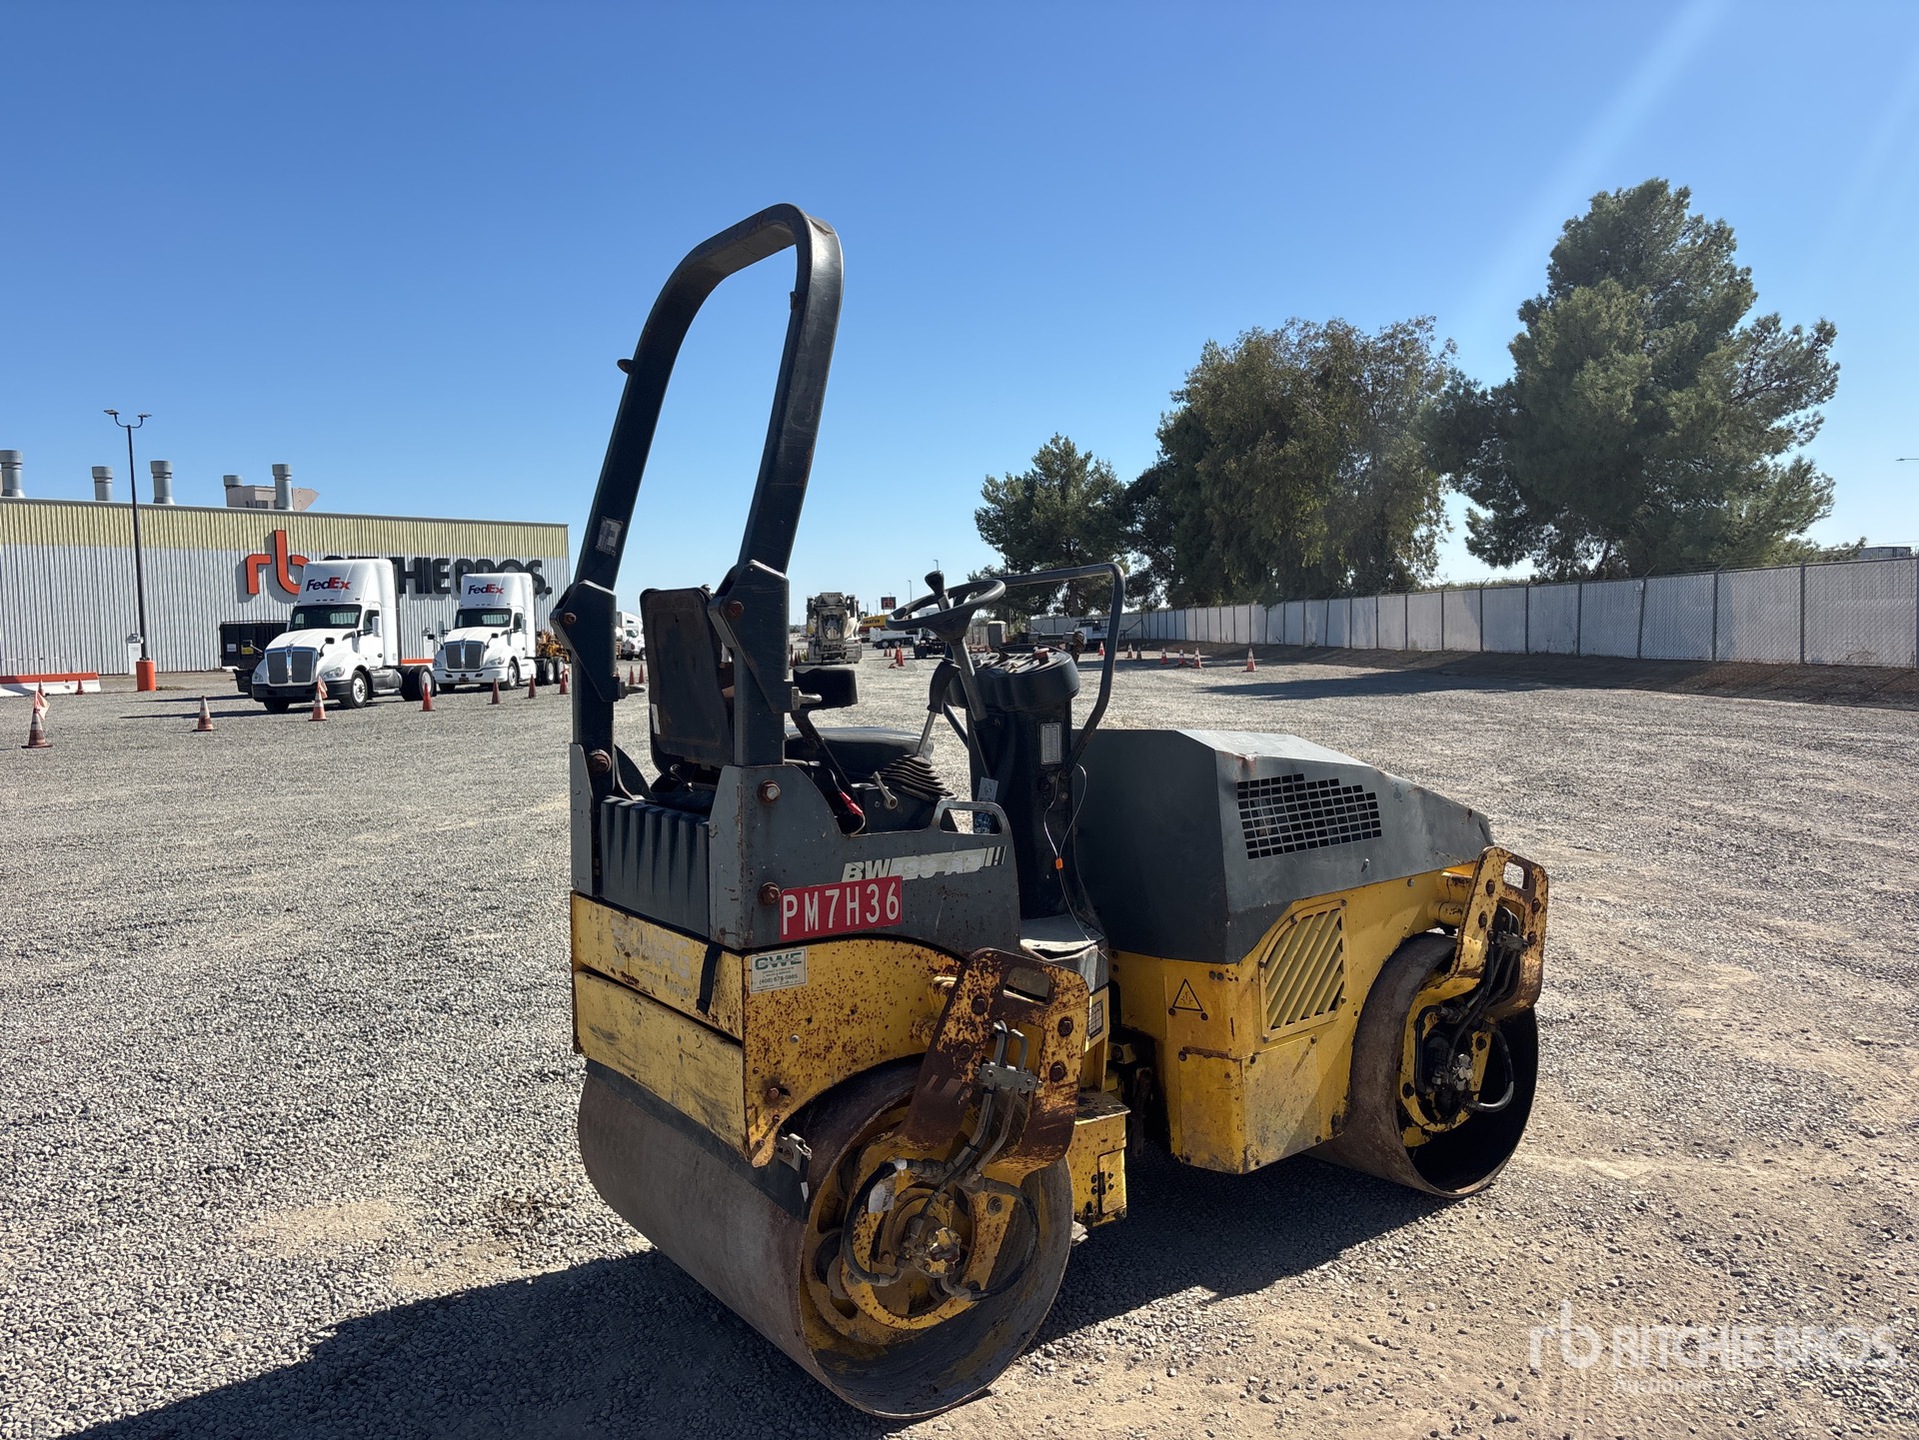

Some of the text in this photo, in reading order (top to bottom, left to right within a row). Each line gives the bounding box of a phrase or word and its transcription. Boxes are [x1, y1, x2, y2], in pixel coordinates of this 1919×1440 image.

[246, 529, 310, 595] rb
[305, 577, 352, 592] FedEx
[467, 583, 504, 595] FedEx
[782, 881, 900, 935] PM7H36
[755, 952, 802, 970] CWE
